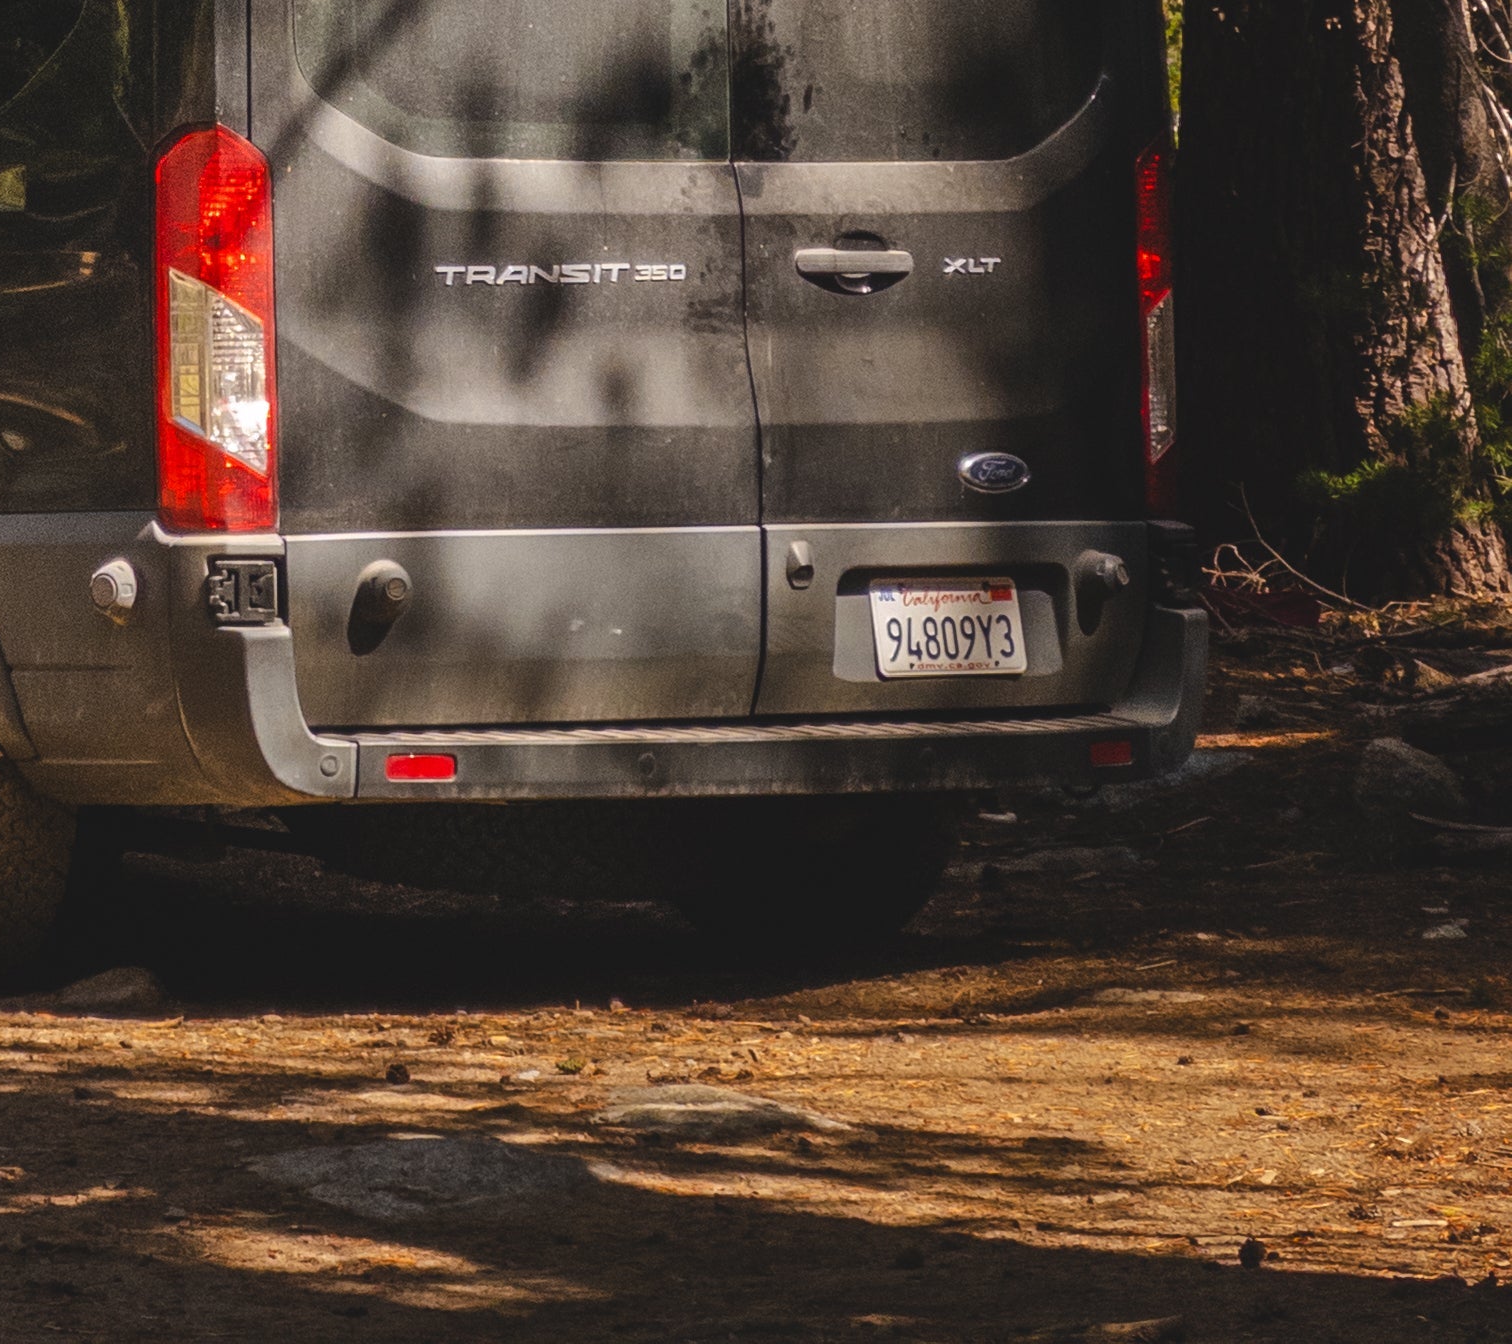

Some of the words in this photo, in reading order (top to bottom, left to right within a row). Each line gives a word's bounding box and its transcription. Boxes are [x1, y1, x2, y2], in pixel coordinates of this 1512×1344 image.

[435, 262, 631, 286] TRANSIT
[634, 264, 687, 282] 350
[943, 257, 1002, 274] XLT
[902, 588, 992, 612] California
[886, 614, 1015, 662] 94809Y3
[917, 662, 992, 670] dmv.ca.gov
